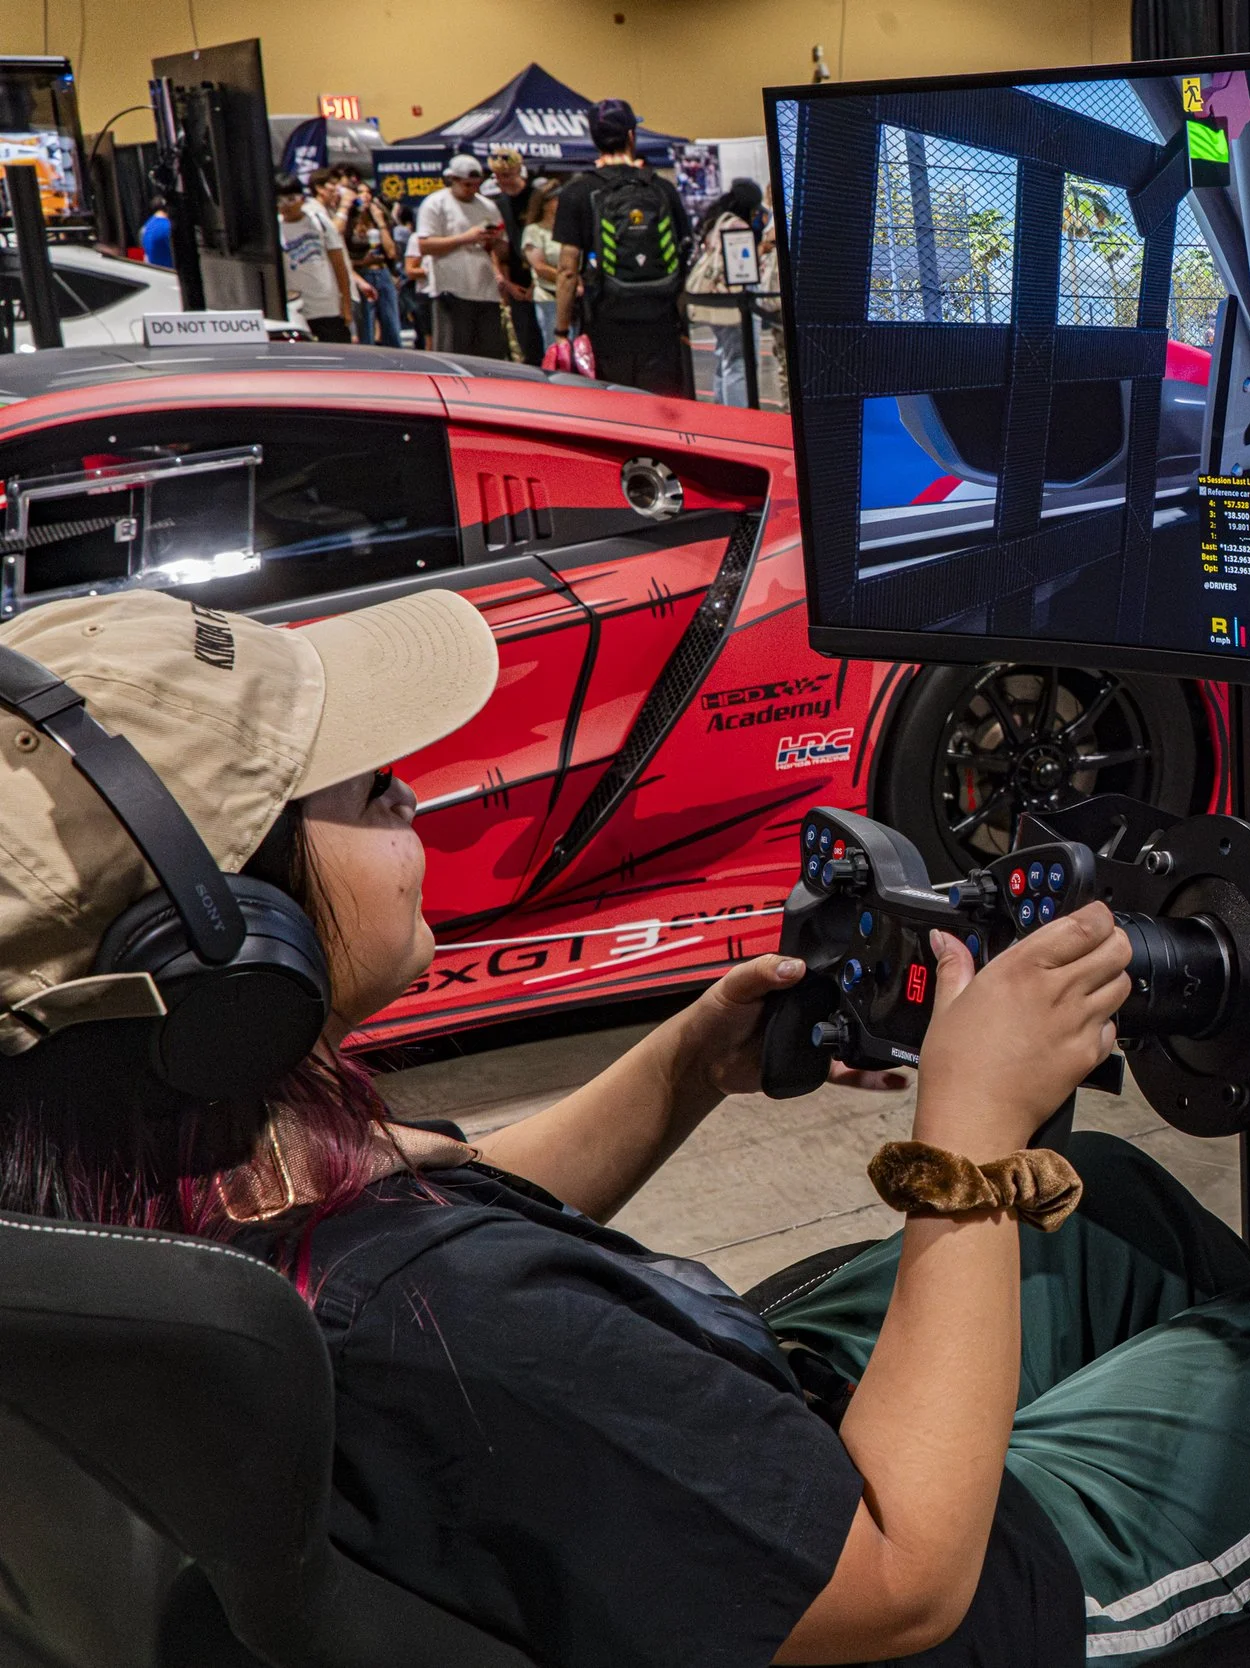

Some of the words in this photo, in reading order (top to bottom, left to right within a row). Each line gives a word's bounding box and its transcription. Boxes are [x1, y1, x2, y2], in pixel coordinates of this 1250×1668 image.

[151, 320, 174, 334] DO
[178, 319, 208, 333] NOT
[211, 319, 261, 333] TOUCH
[1207, 475, 1231, 485] Session
[1232, 477, 1246, 486] Last
[1207, 487, 1239, 497] Reference
[1240, 490, 1250, 498] car
[1209, 499, 1216, 507] 4:
[1209, 510, 1216, 518] 3:
[1209, 521, 1216, 529] 2:
[1201, 542, 1217, 551] Last:
[1201, 553, 1218, 561] Best:
[1204, 563, 1218, 573] Opt:
[1204, 581, 1237, 591] @DRIVERS
[1211, 617, 1228, 634] R
[1216, 636, 1231, 645] mph
[706, 699, 832, 733] Academy
[776, 727, 854, 765] HRC
[1031, 871, 1040, 880] PIT
[1051, 872, 1061, 881] FCY
[195, 884, 225, 931] SONY
[1042, 905, 1049, 915] Fn
